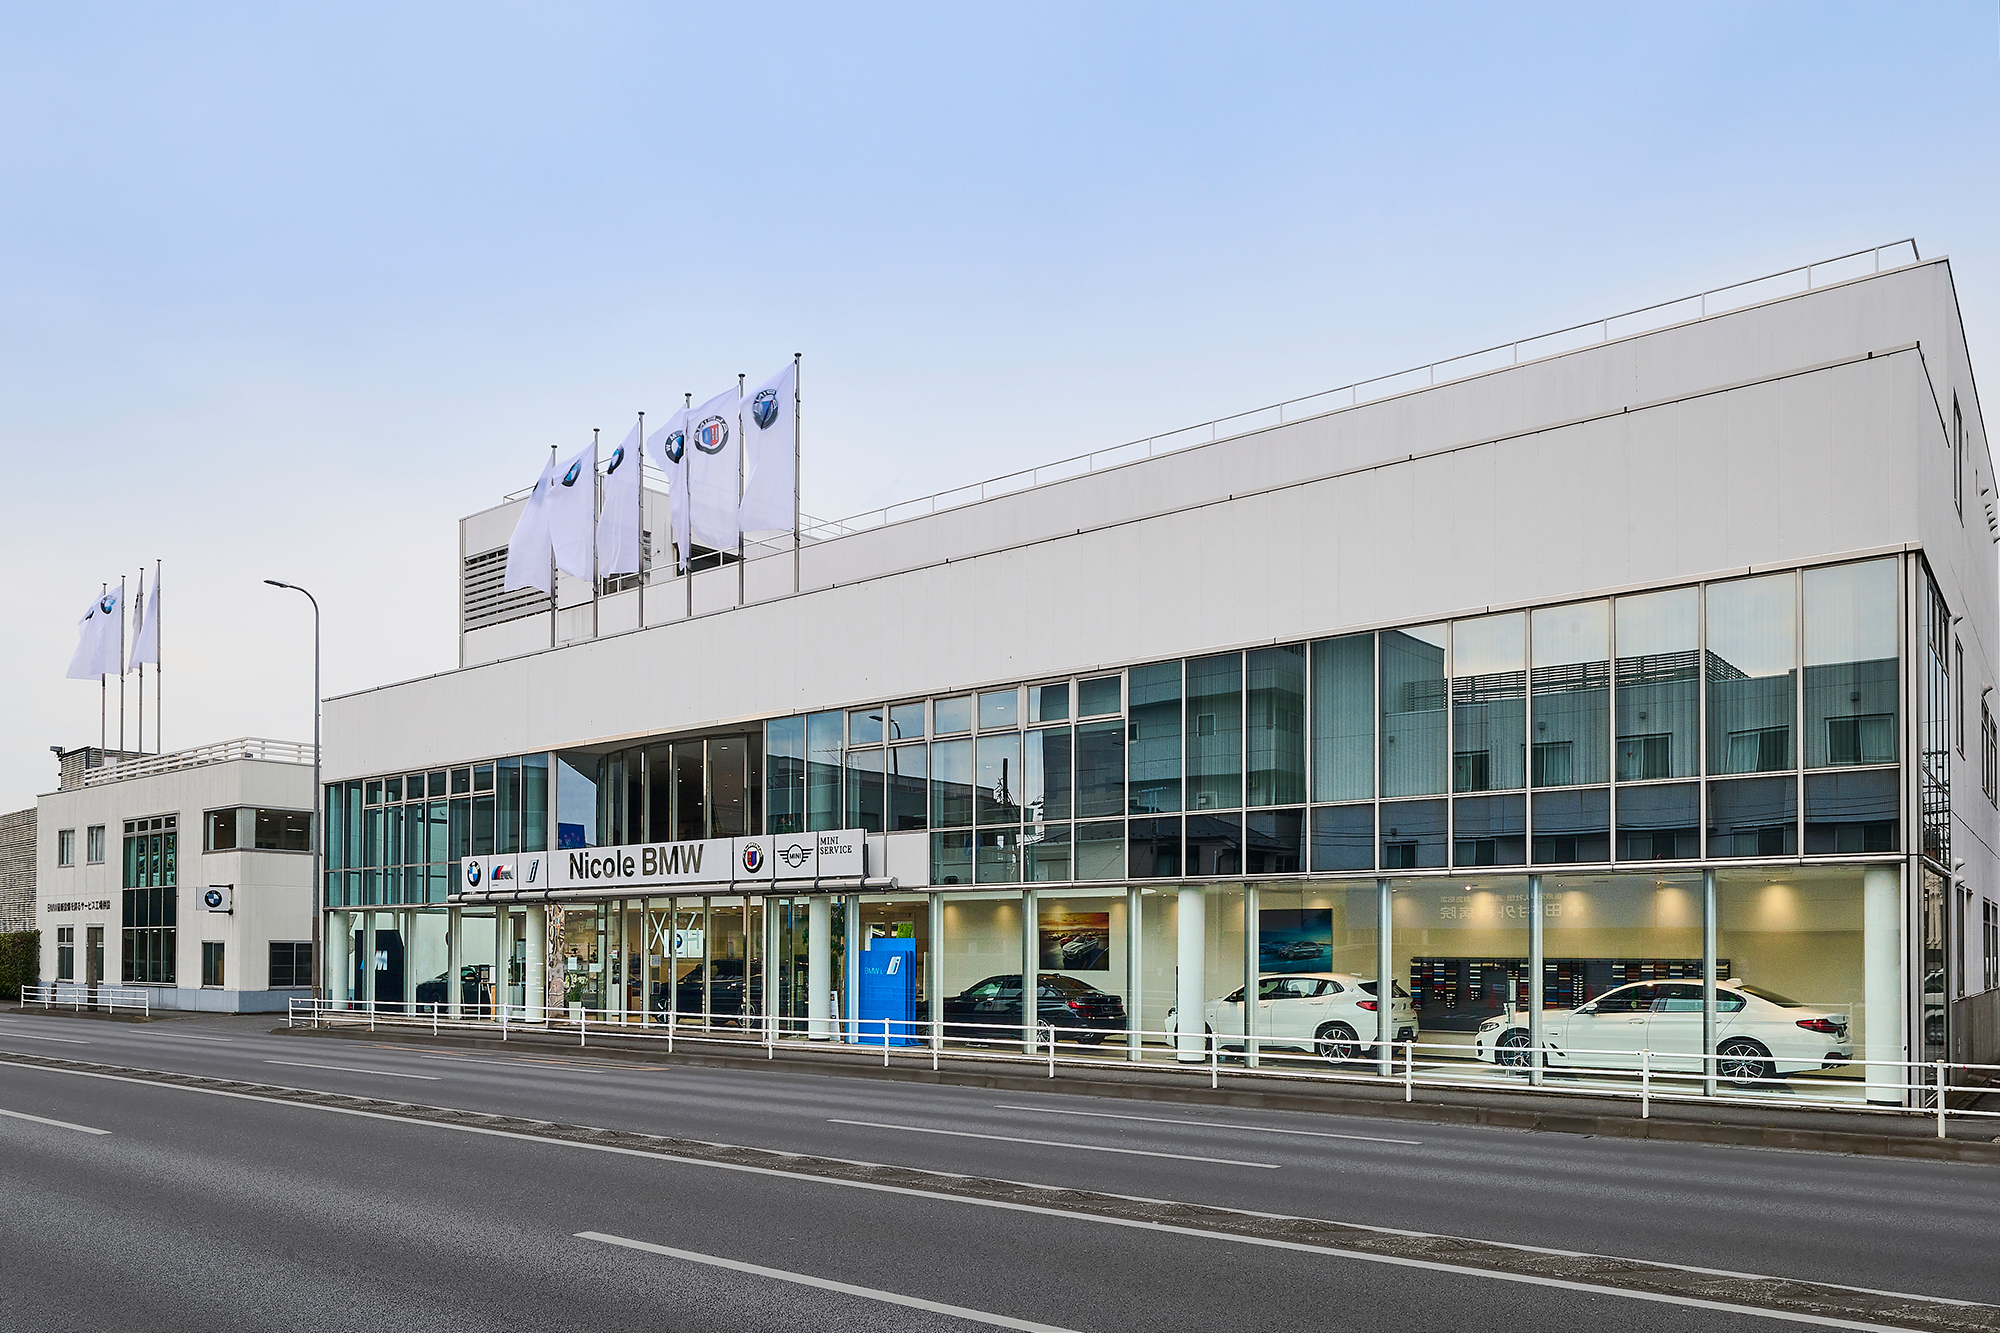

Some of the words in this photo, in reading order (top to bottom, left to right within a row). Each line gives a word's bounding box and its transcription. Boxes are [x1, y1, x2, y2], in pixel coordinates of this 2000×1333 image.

[820, 836, 839, 846] MINI
[820, 845, 853, 855] SERVICE
[569, 849, 636, 880] Nicole
[641, 843, 704, 876] BMW
